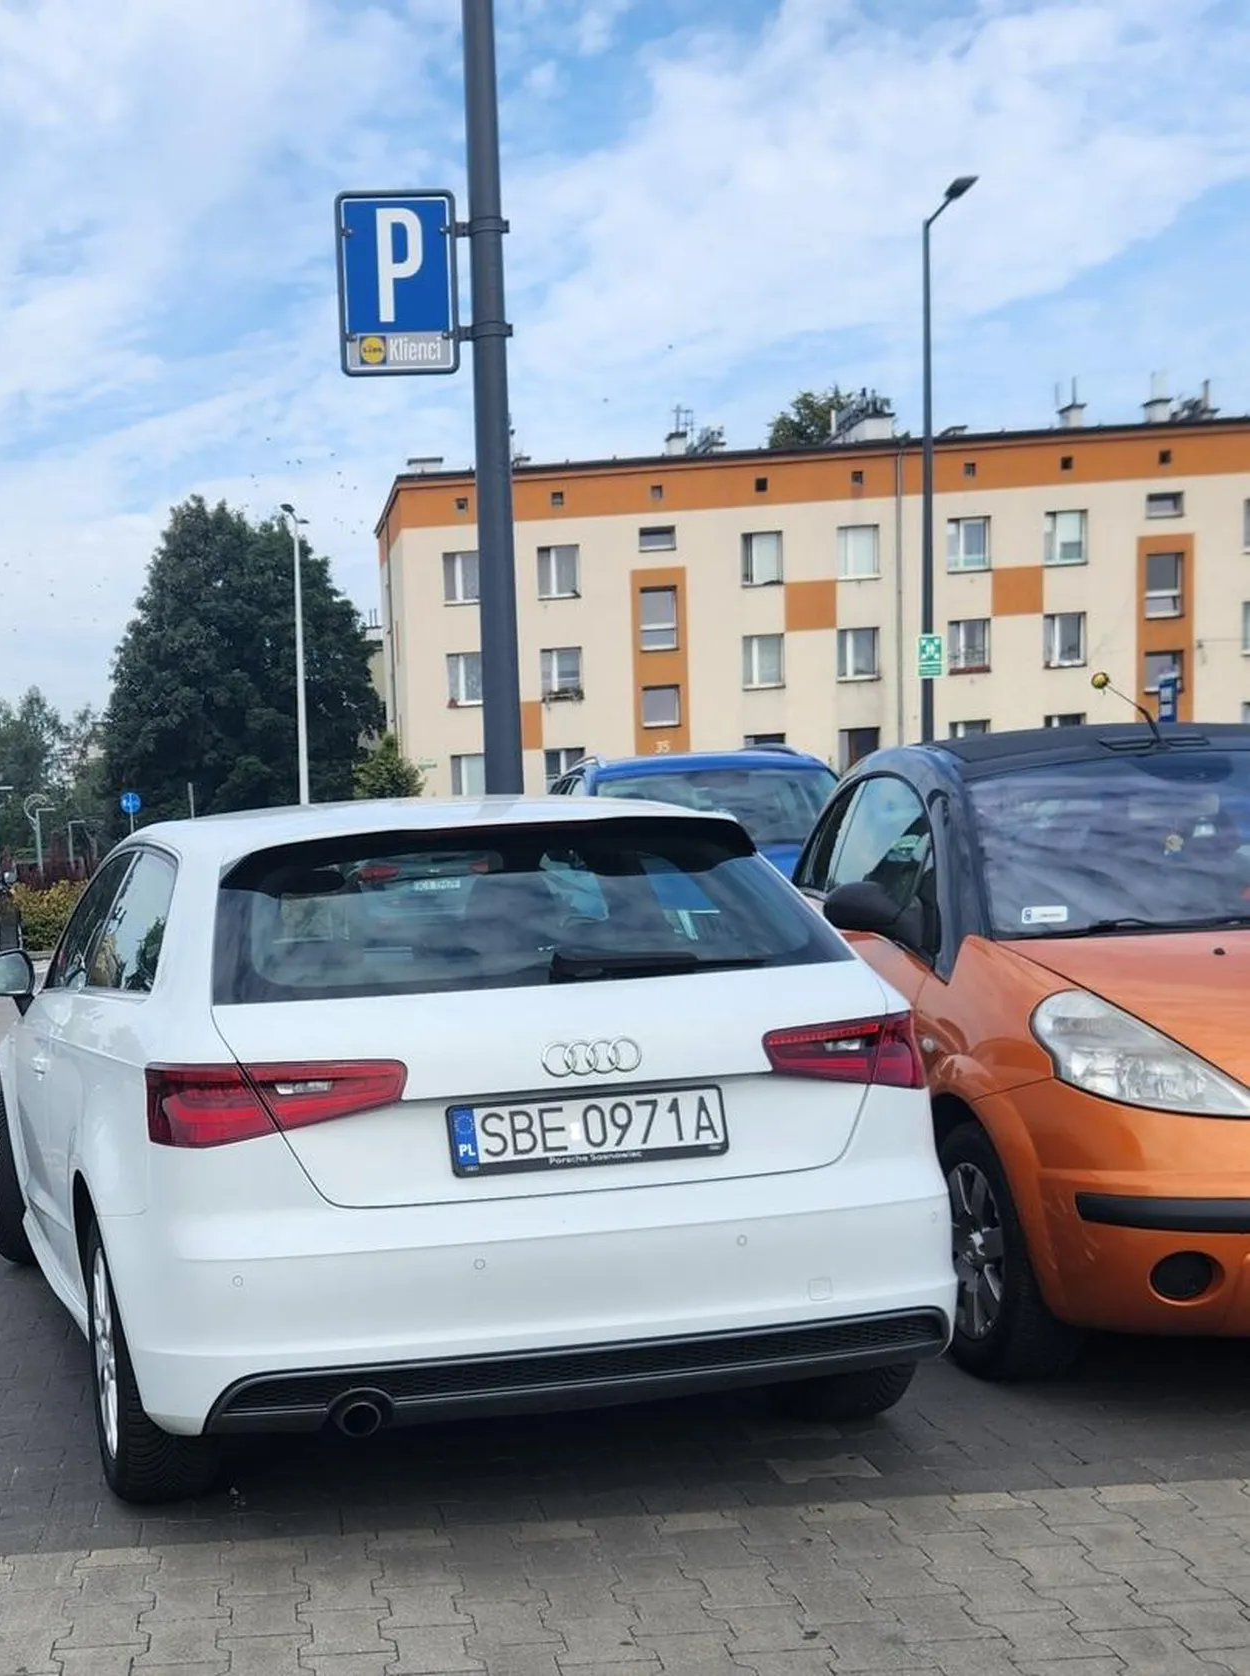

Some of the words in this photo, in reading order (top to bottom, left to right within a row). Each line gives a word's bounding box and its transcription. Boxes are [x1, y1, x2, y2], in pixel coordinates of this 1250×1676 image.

[376, 207, 424, 323] P
[390, 336, 442, 361] Klienci
[480, 1106, 568, 1156] SBE
[581, 1096, 719, 1148] 0971A
[459, 1143, 476, 1157] PL
